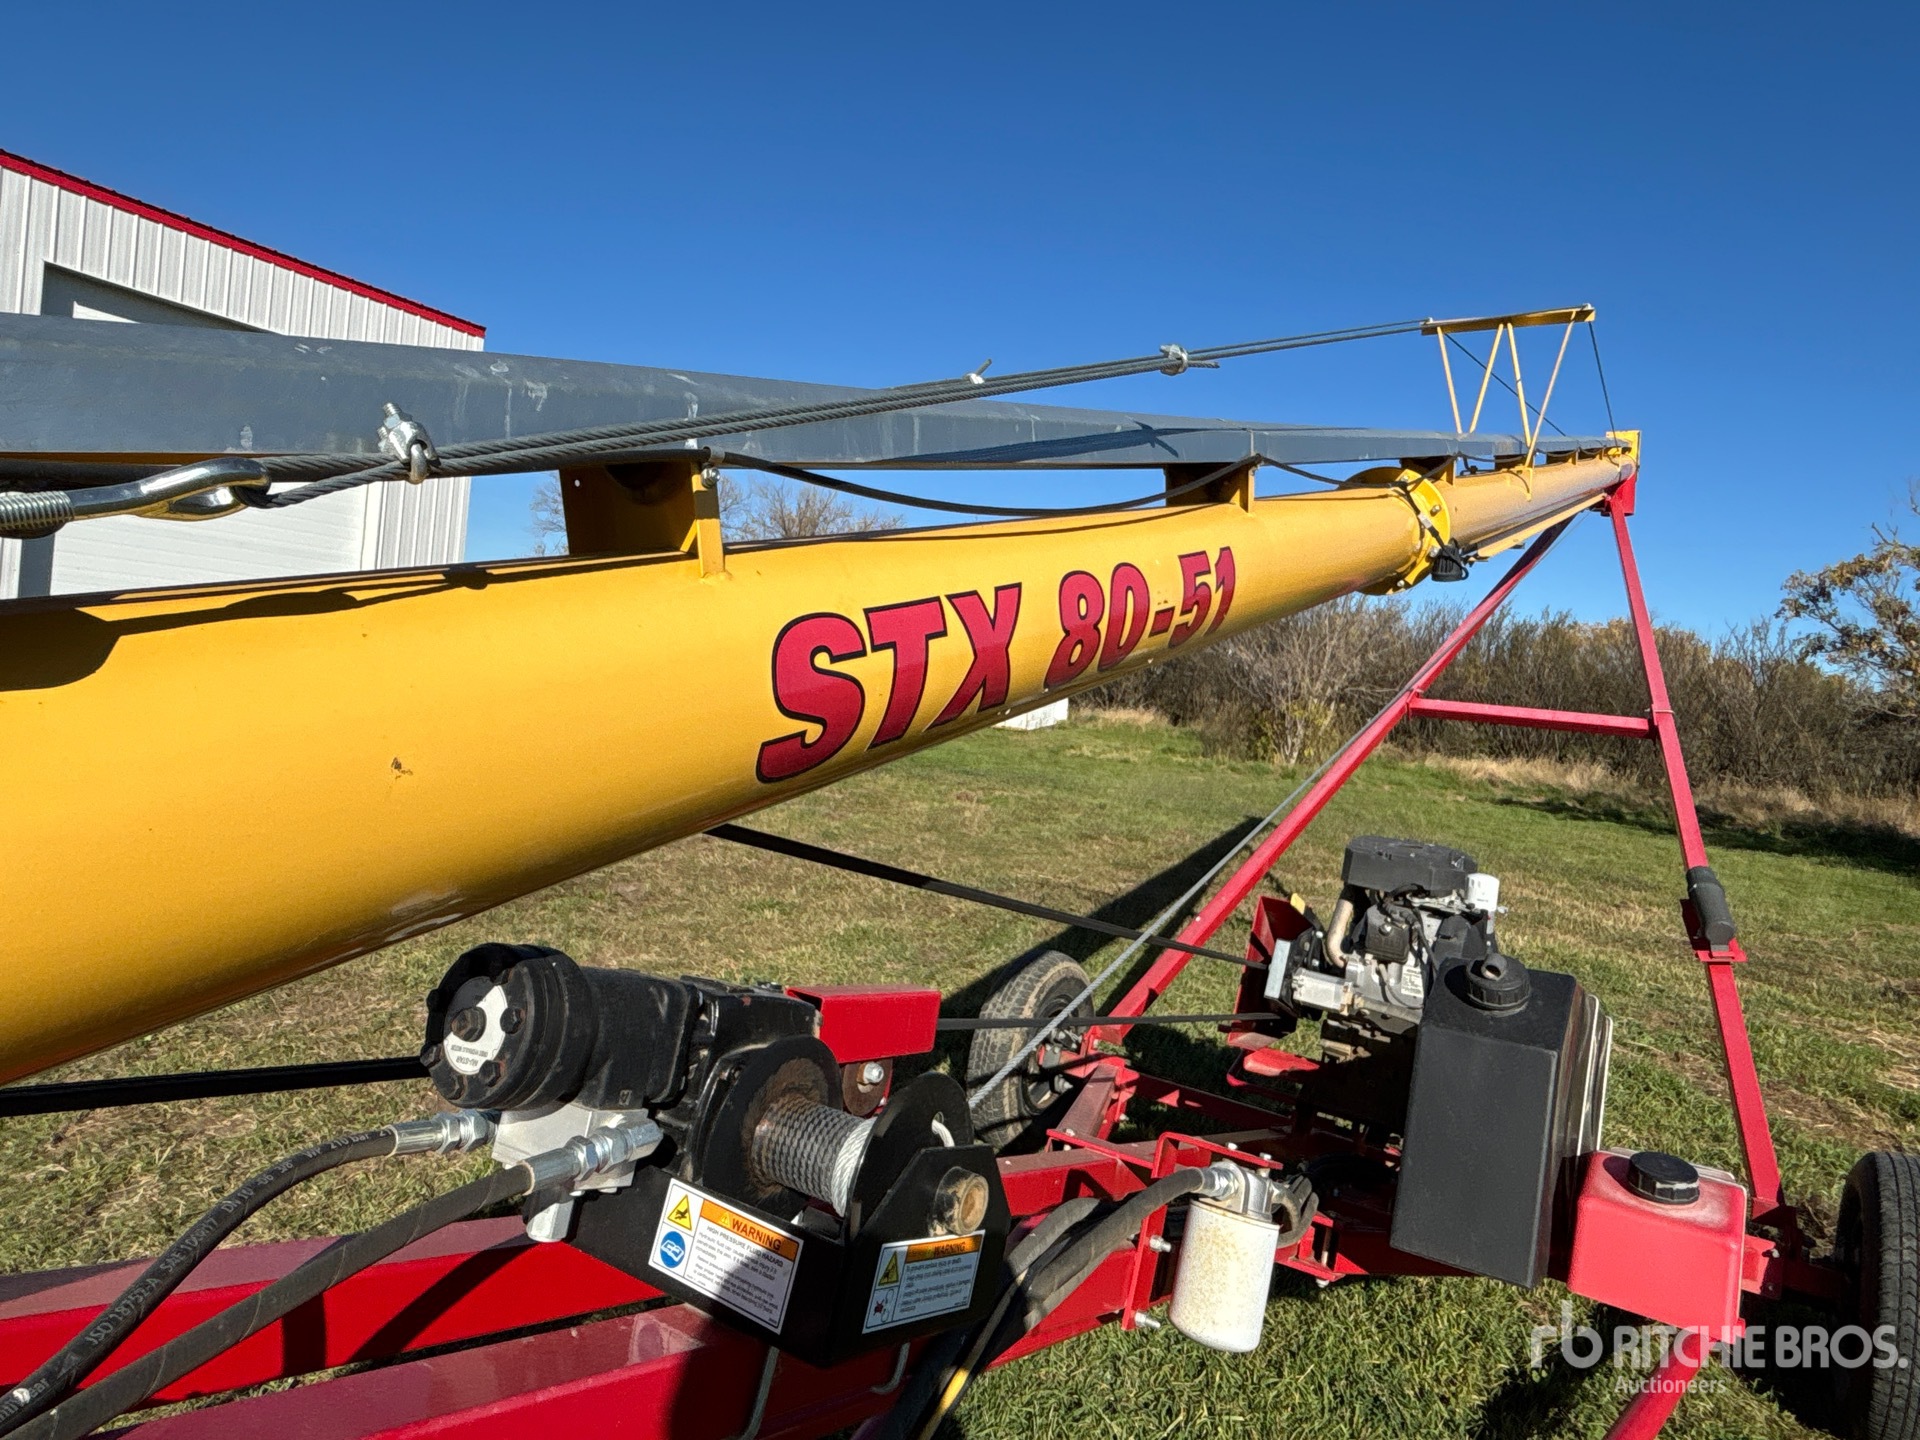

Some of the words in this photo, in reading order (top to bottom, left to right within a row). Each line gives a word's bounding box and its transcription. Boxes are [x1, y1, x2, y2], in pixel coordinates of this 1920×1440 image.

[756, 582, 1022, 784] STX
[1044, 546, 1236, 689] 80-51
[160, 1250, 187, 1273] SAE
[350, 1132, 369, 1144] bar
[718, 1231, 746, 1249] PRESSURE
[745, 1244, 761, 1257] FLUID
[761, 1252, 783, 1267] HAZARD
[730, 1218, 782, 1251] WARNING
[932, 1240, 966, 1256] WARNING
